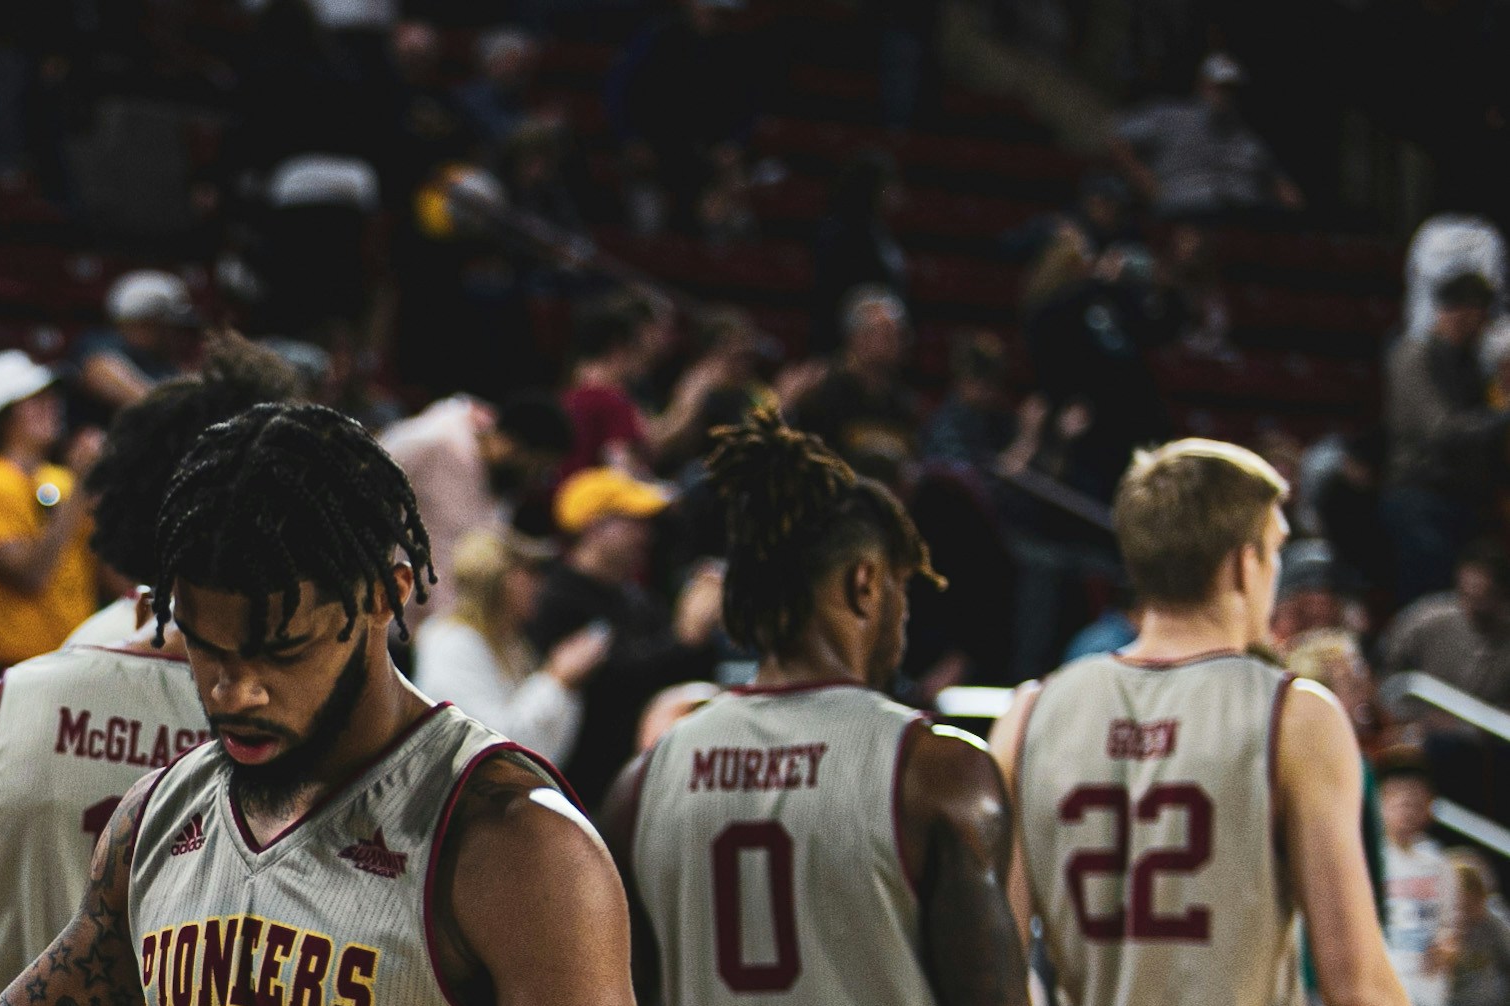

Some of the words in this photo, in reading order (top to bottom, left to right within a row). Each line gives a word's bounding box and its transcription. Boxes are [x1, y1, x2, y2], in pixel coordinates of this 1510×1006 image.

[689, 741, 828, 793] MURKEY
[711, 818, 803, 994] 0
[1060, 781, 1213, 943] 22
